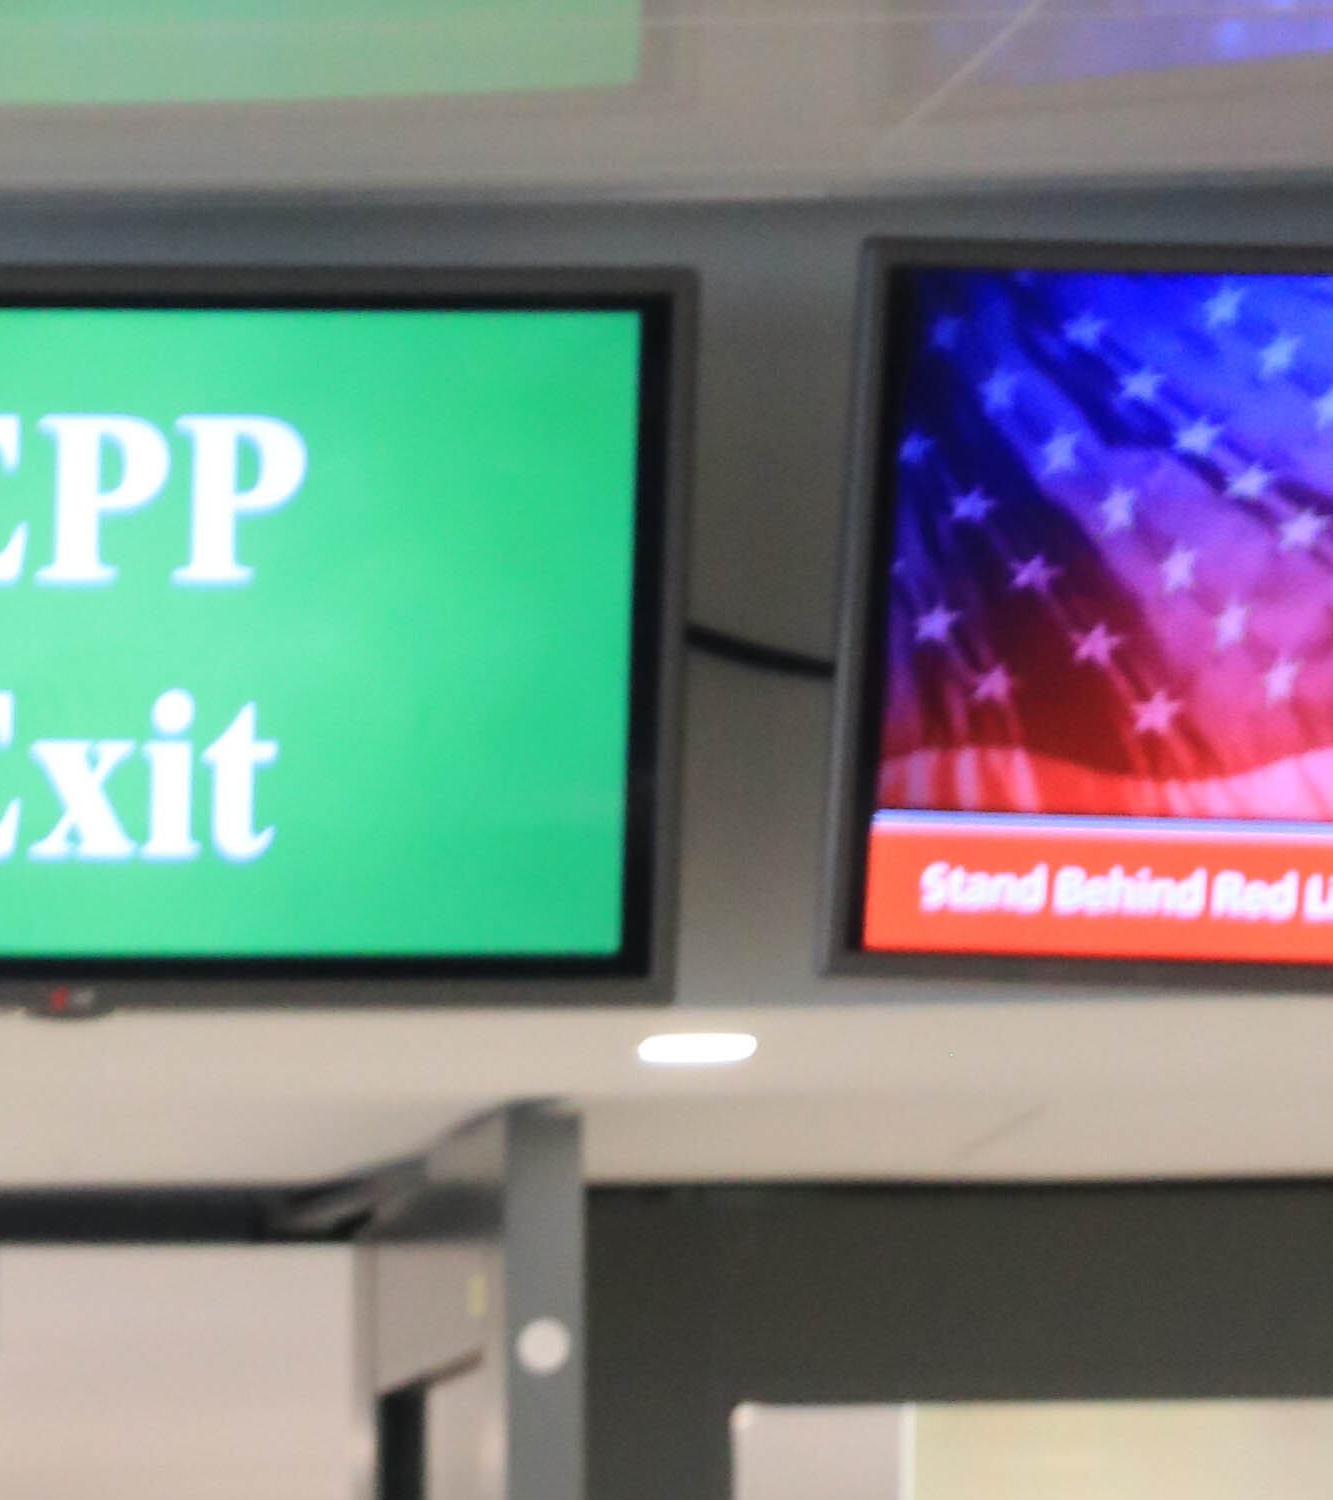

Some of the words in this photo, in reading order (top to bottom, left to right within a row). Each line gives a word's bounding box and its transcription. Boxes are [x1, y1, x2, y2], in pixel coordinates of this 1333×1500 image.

[919, 861, 1049, 916] Stand
[1052, 864, 1209, 920] Behind
[1210, 869, 1300, 924] Red
